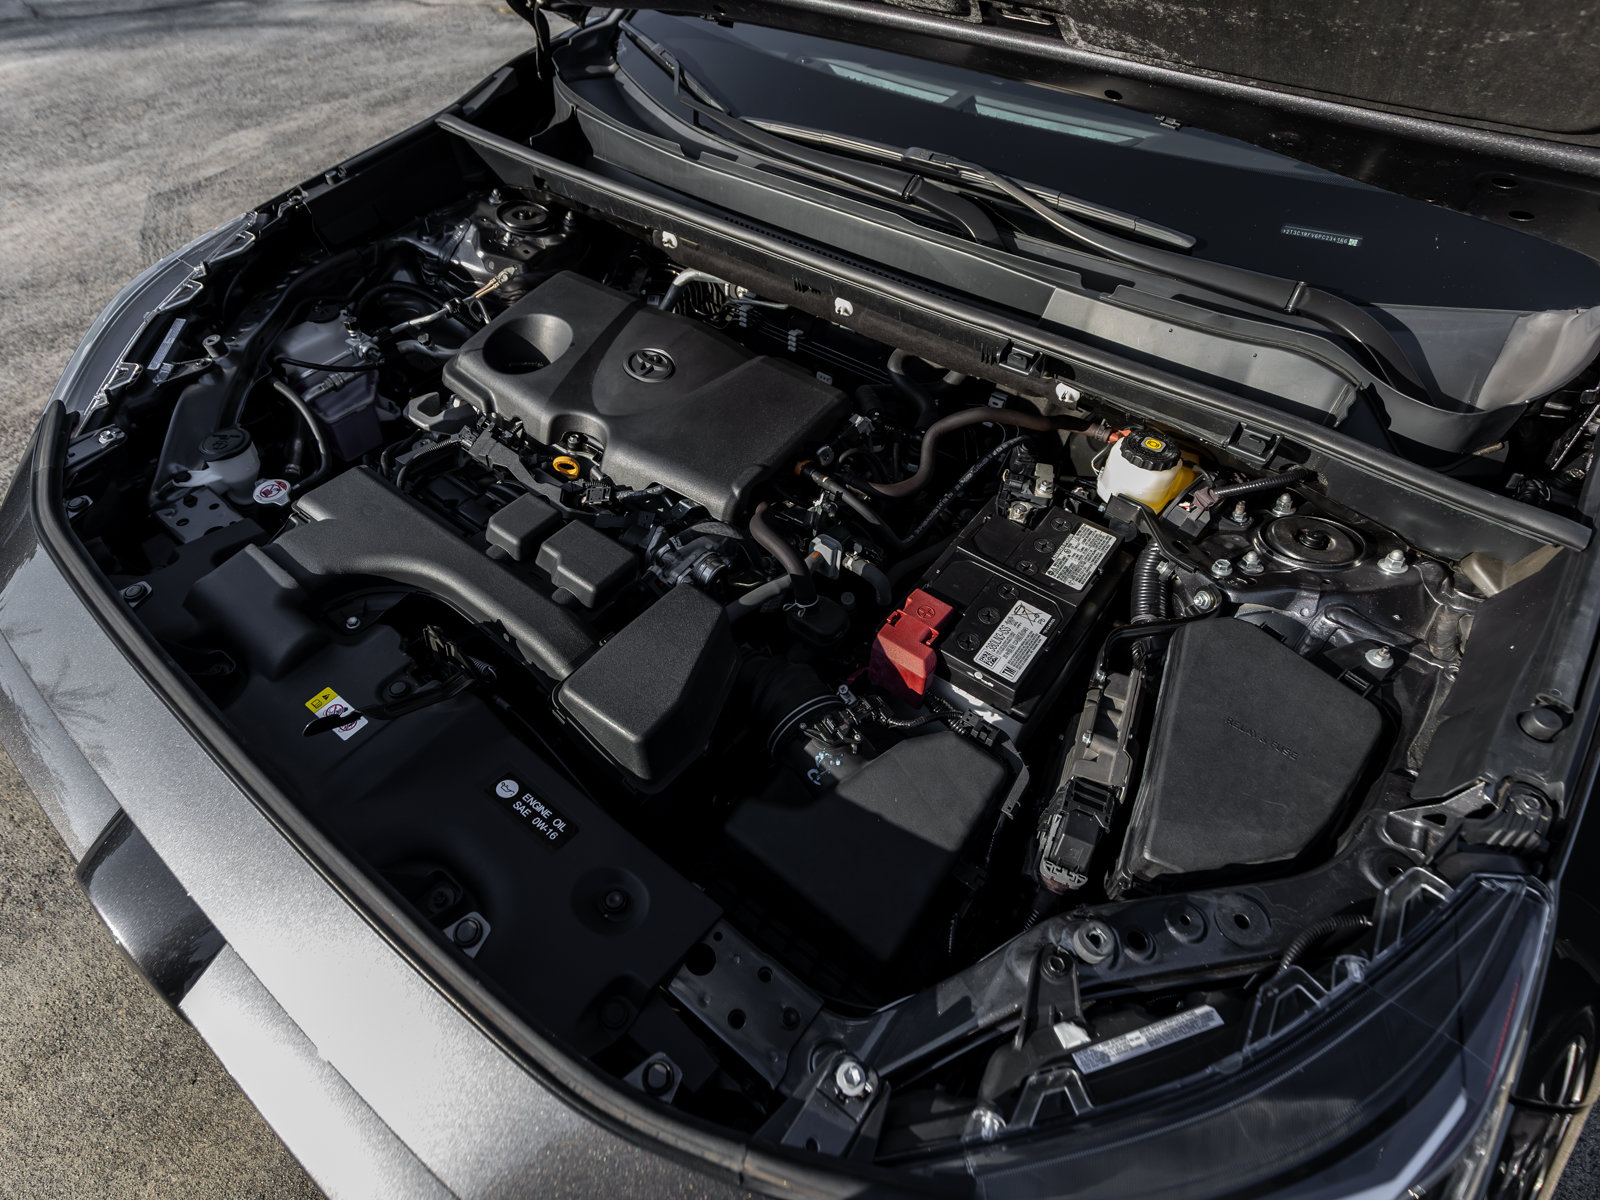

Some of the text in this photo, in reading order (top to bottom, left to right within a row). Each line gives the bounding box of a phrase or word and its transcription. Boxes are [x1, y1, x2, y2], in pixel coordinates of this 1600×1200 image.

[1271, 741, 1299, 761] FUSE
[512, 800, 559, 840] SAE 0W-16
[521, 793, 567, 833] ENGINE OIL
